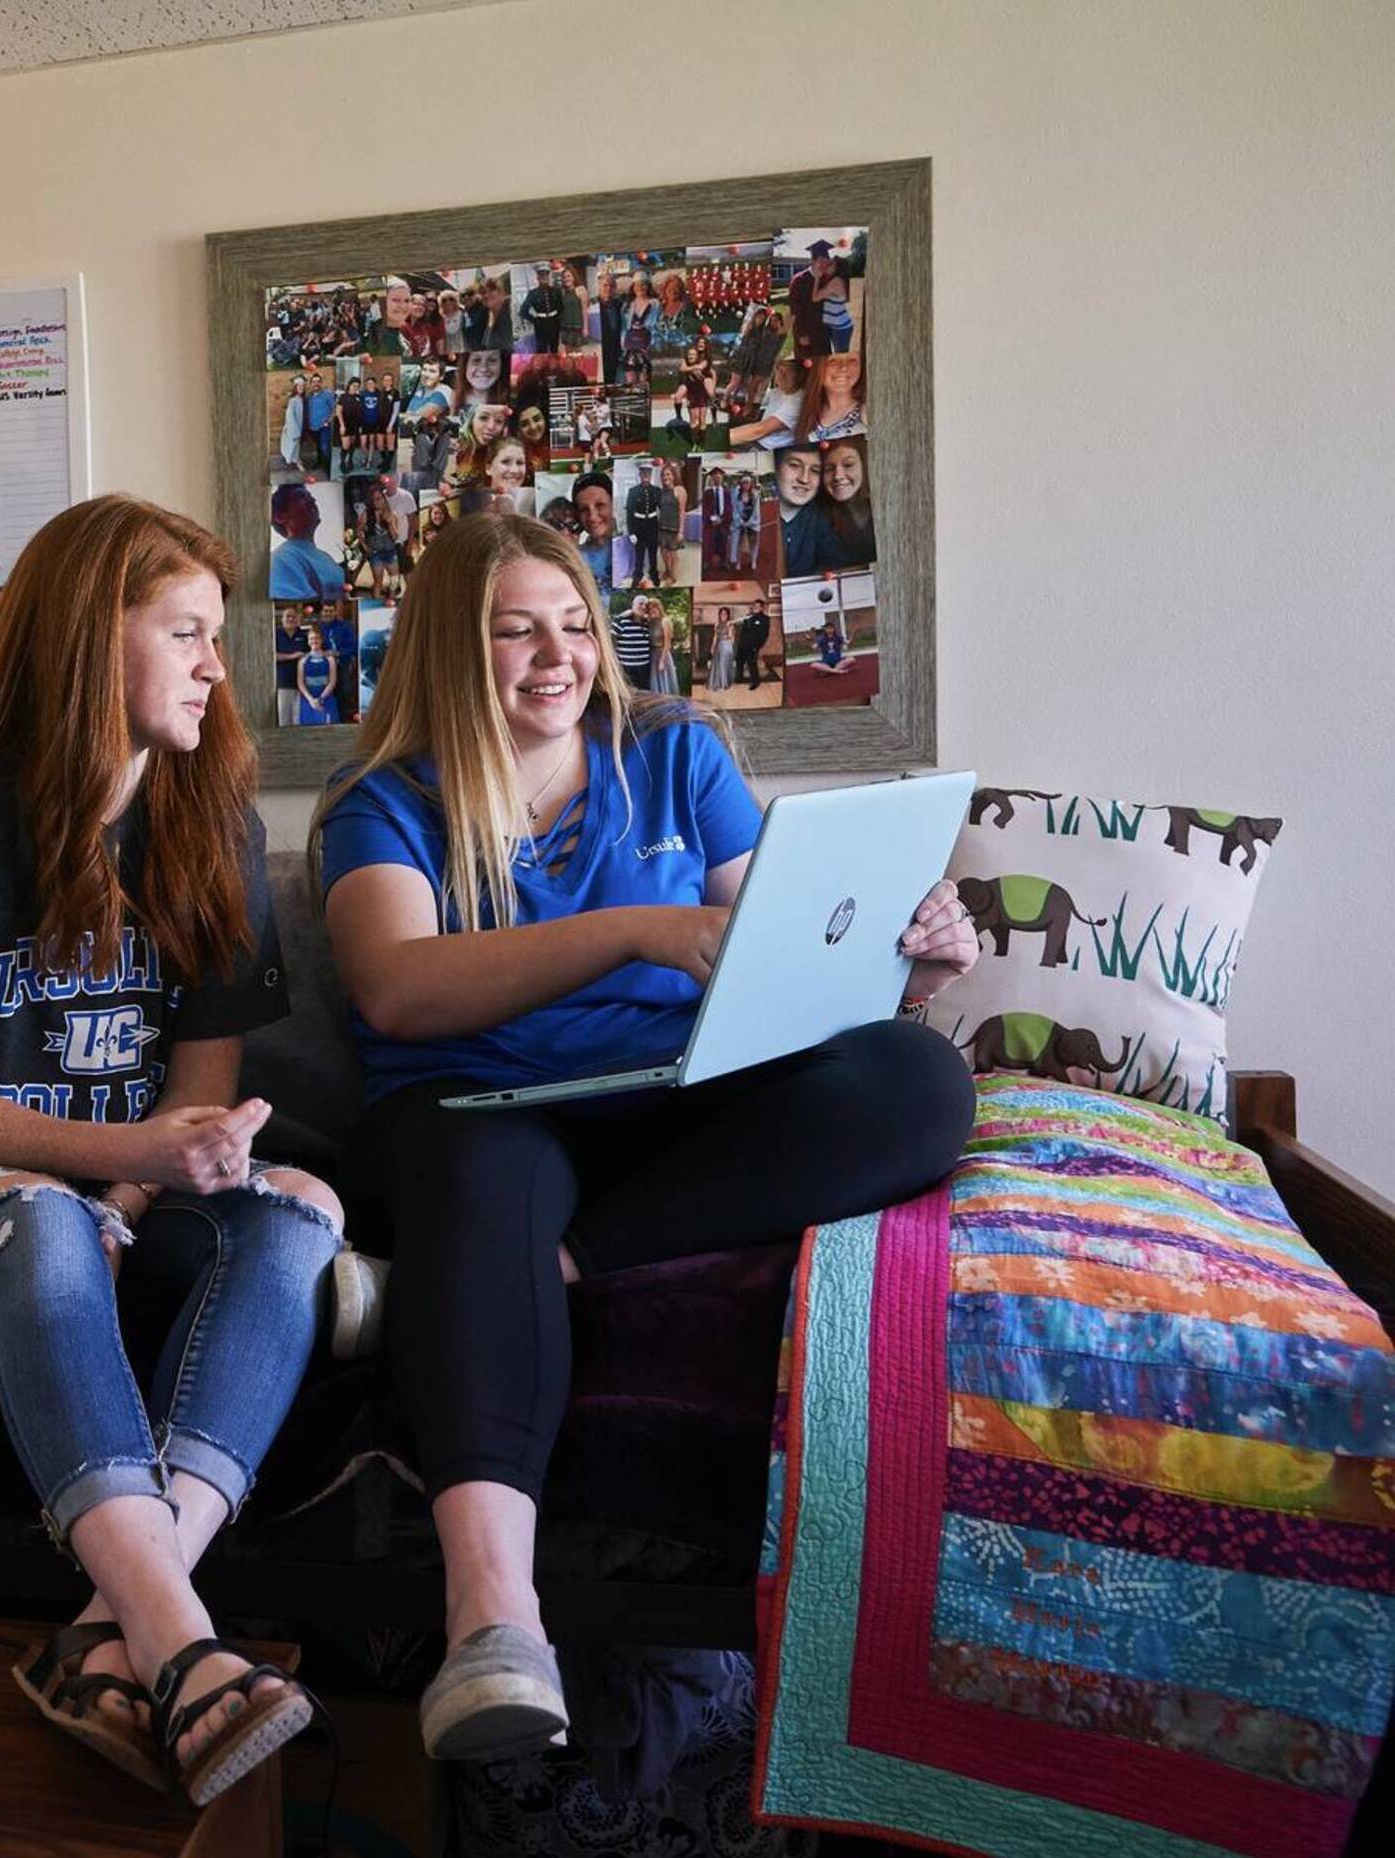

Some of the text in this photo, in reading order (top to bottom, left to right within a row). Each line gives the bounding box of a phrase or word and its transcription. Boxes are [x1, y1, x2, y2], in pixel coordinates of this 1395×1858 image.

[13, 390, 43, 400] Varsity
[826, 897, 855, 946] hp
[62, 1006, 143, 1074] UC
